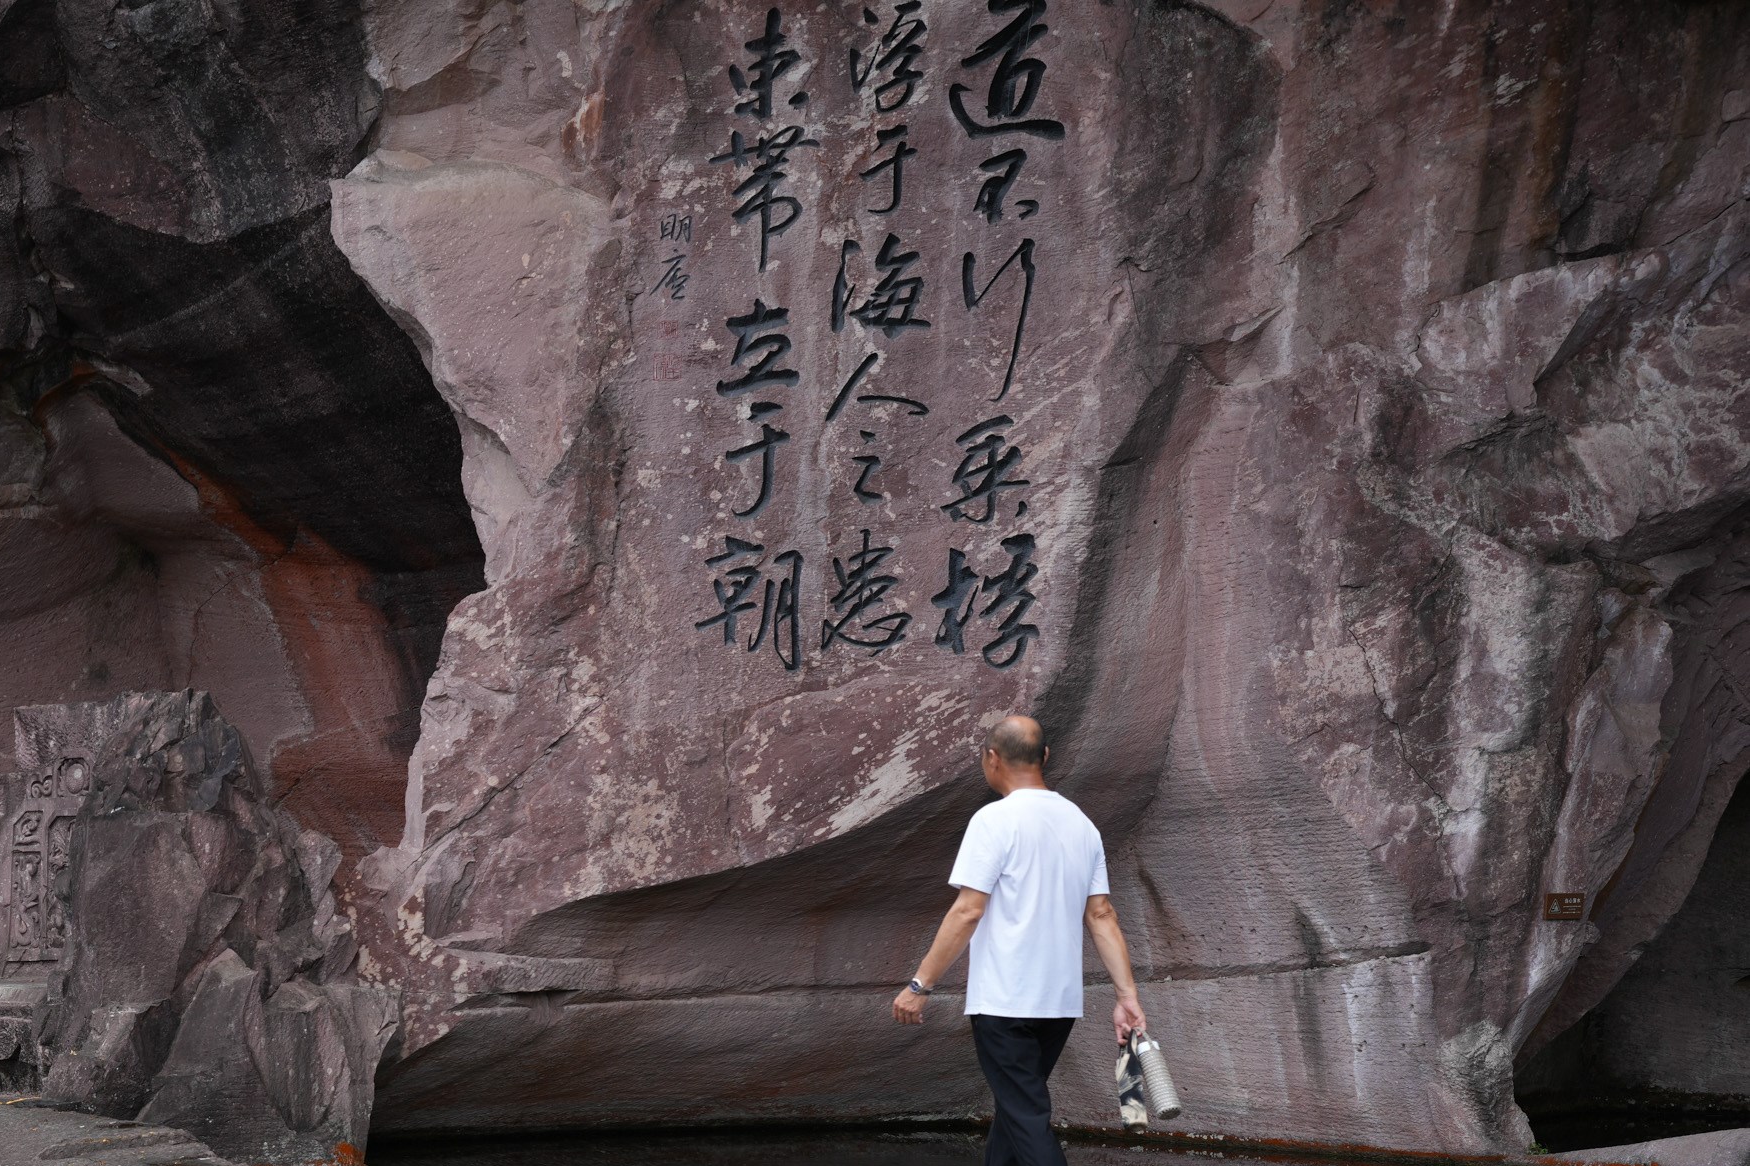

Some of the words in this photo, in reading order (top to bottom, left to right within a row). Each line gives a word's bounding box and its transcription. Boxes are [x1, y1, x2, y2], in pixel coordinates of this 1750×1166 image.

[932, 0, 1065, 671] 道不行乘桴
